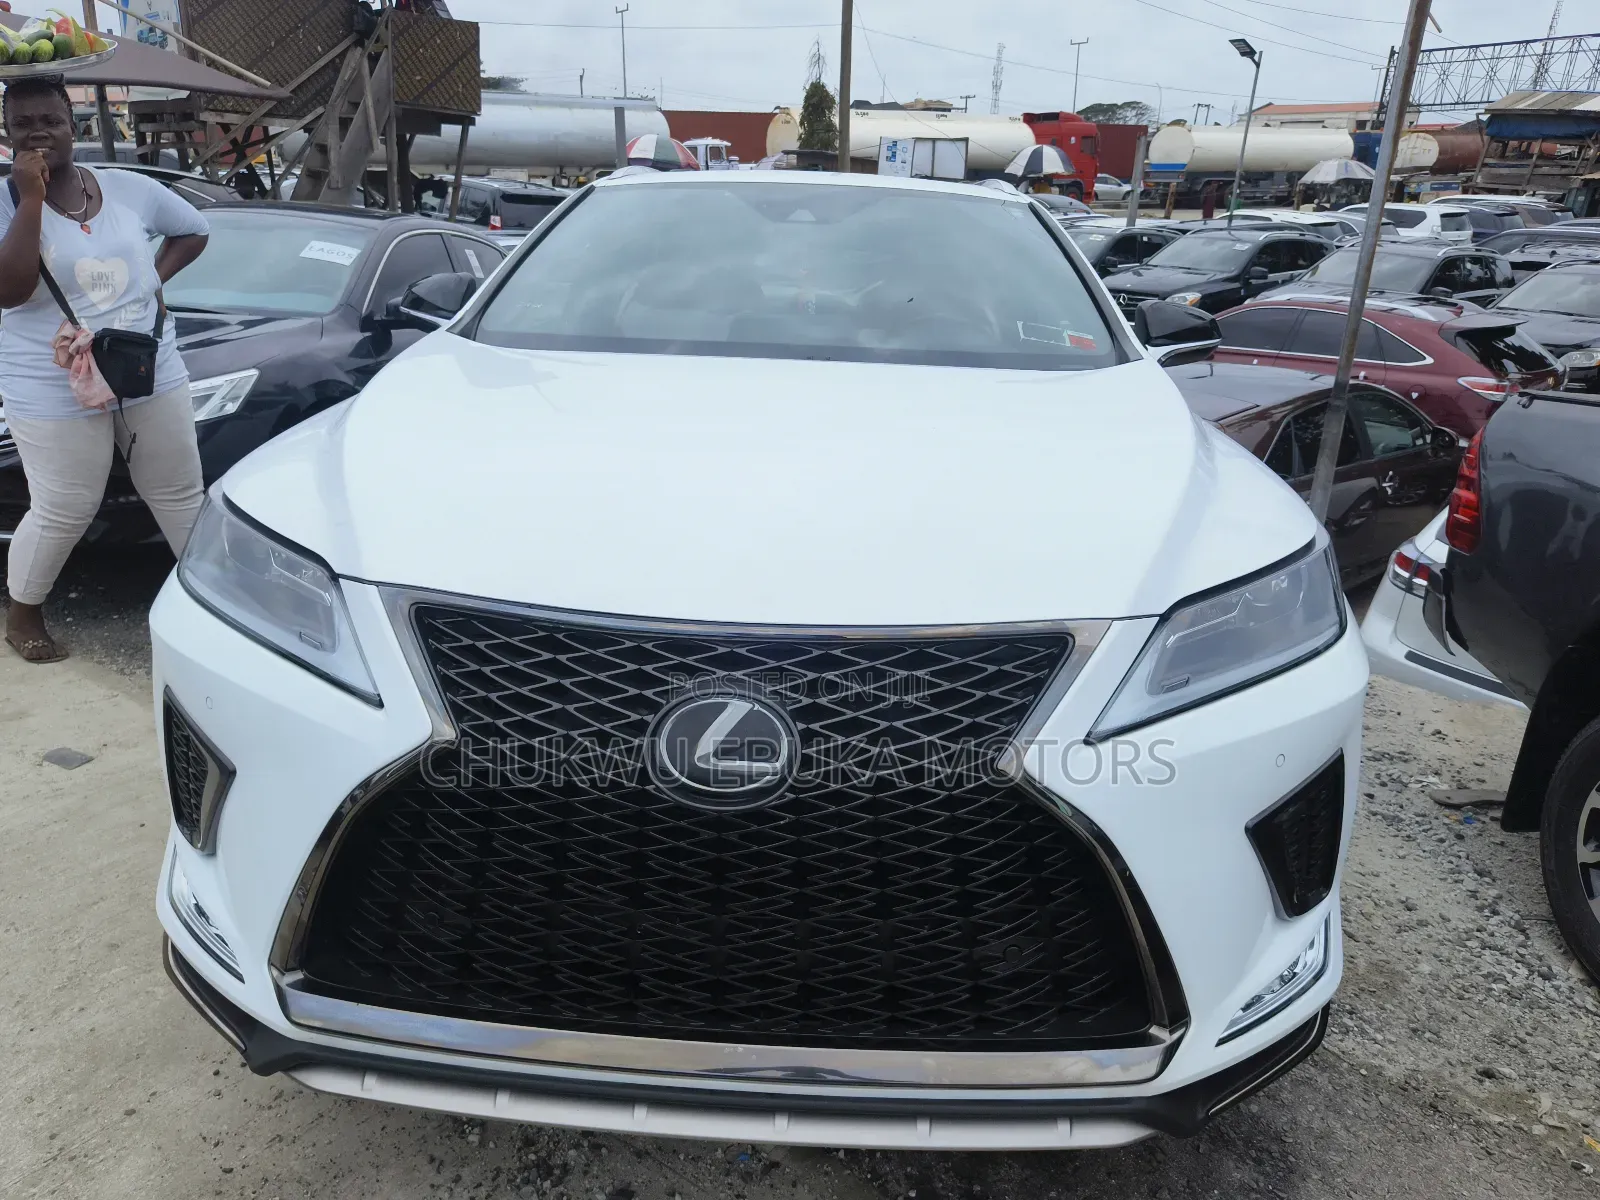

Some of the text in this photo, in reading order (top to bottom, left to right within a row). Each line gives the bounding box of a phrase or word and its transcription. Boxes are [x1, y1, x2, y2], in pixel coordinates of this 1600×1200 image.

[307, 244, 355, 260] LAGOS
[91, 271, 116, 282] LOVE
[91, 282, 117, 294] PINK
